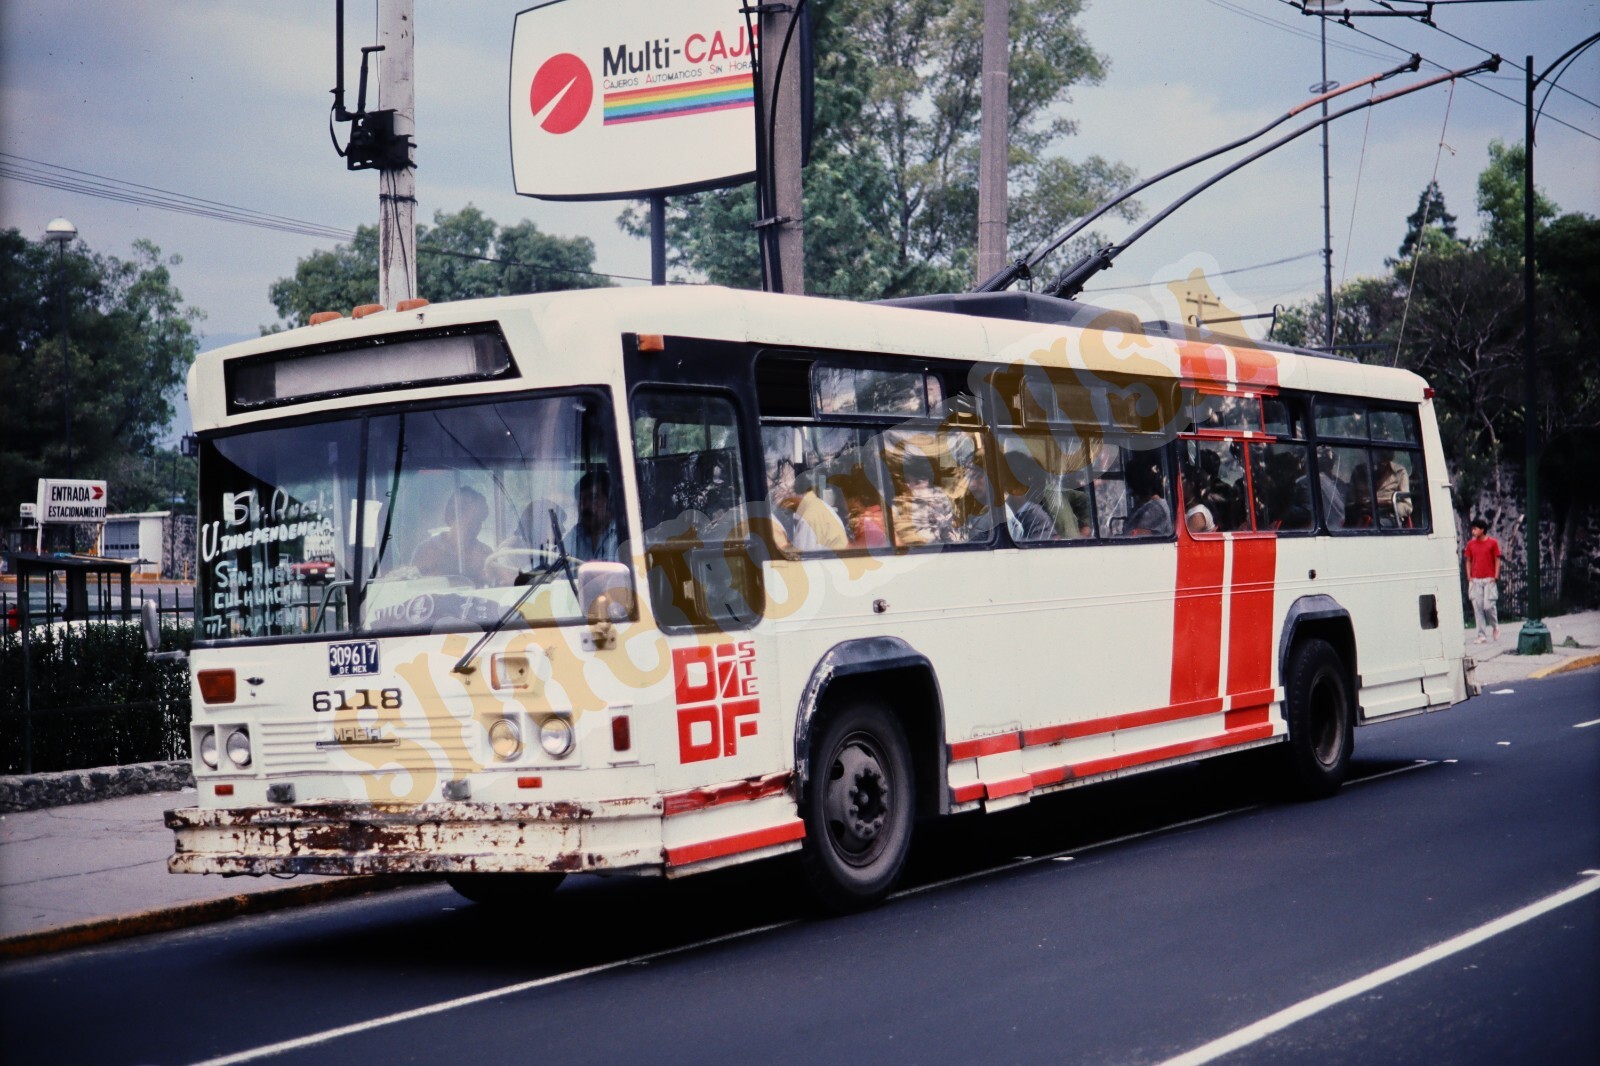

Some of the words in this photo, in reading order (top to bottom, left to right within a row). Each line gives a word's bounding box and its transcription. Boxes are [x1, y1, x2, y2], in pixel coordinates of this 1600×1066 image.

[645, 69, 703, 84] AUTOMATICOS
[51, 486, 91, 502] ENTRADA
[48, 505, 107, 518] ESTACIONAMIENTO
[329, 644, 377, 667] 309617
[339, 666, 349, 674] DE
[352, 664, 368, 673] MEX
[312, 687, 403, 713] 6118
